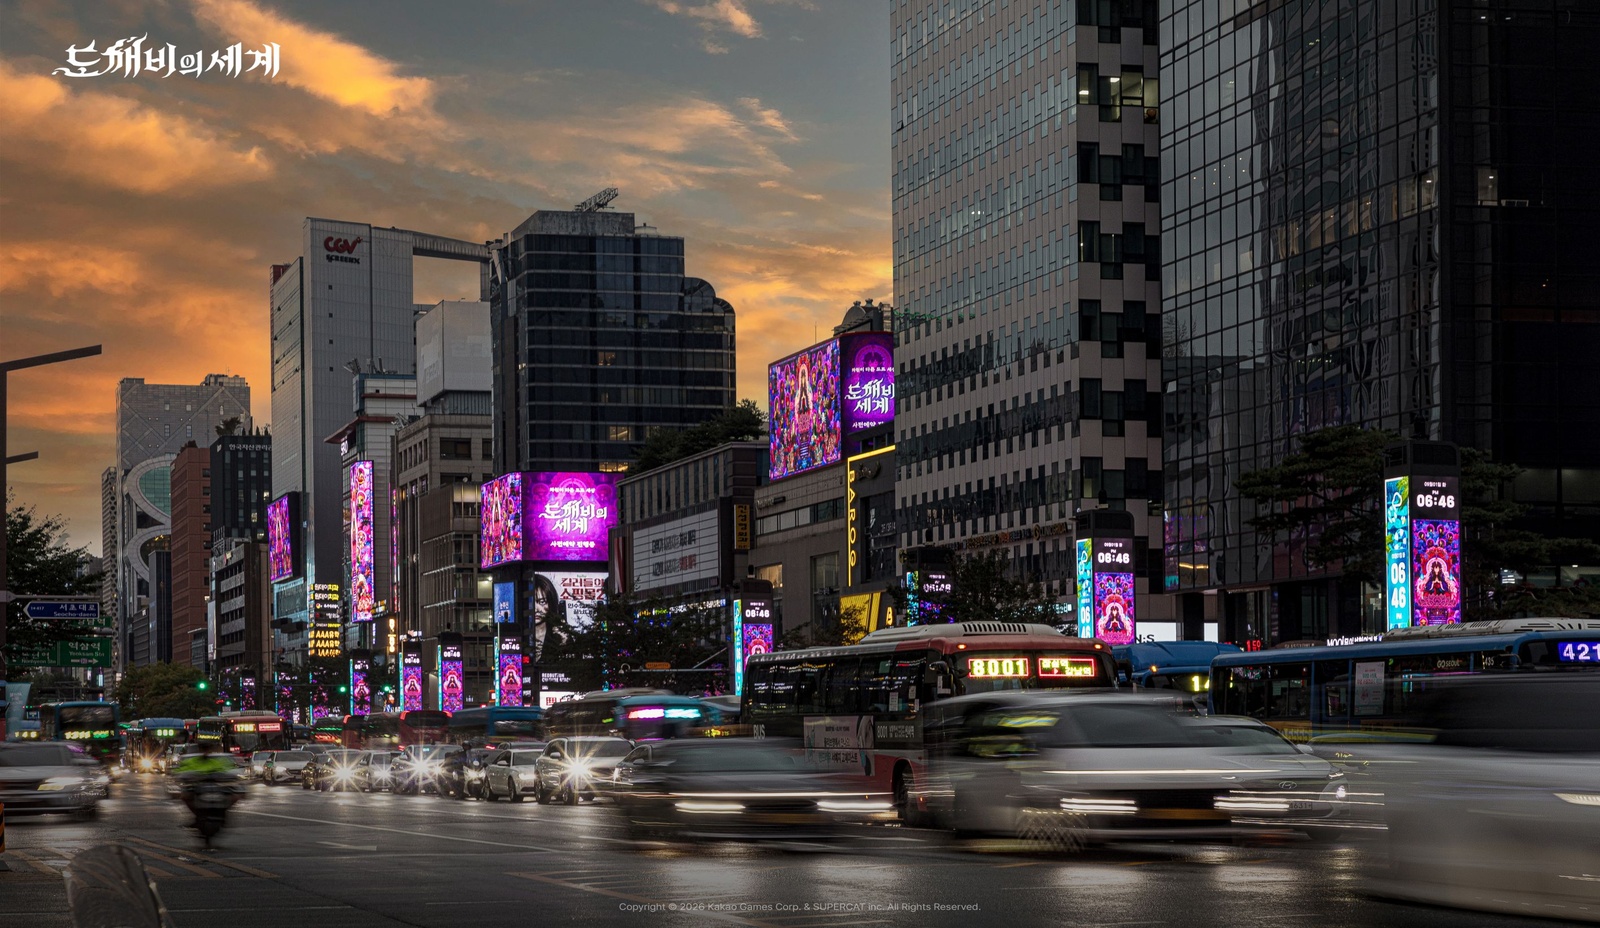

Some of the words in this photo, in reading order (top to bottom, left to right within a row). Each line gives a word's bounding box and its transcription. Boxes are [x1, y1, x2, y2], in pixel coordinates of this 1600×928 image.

[324, 236, 357, 254] CGV
[853, 397, 889, 414] 세계
[1417, 494, 1455, 508] 06:46
[551, 517, 588, 535] 세계
[1391, 562, 1406, 585] 06
[1391, 588, 1406, 609] 46
[60, 604, 96, 612] 서초대로
[1081, 605, 1090, 624] 06
[68, 641, 101, 650] 역삼역
[972, 659, 1025, 676] 8001
[753, 724, 766, 740] BUS
